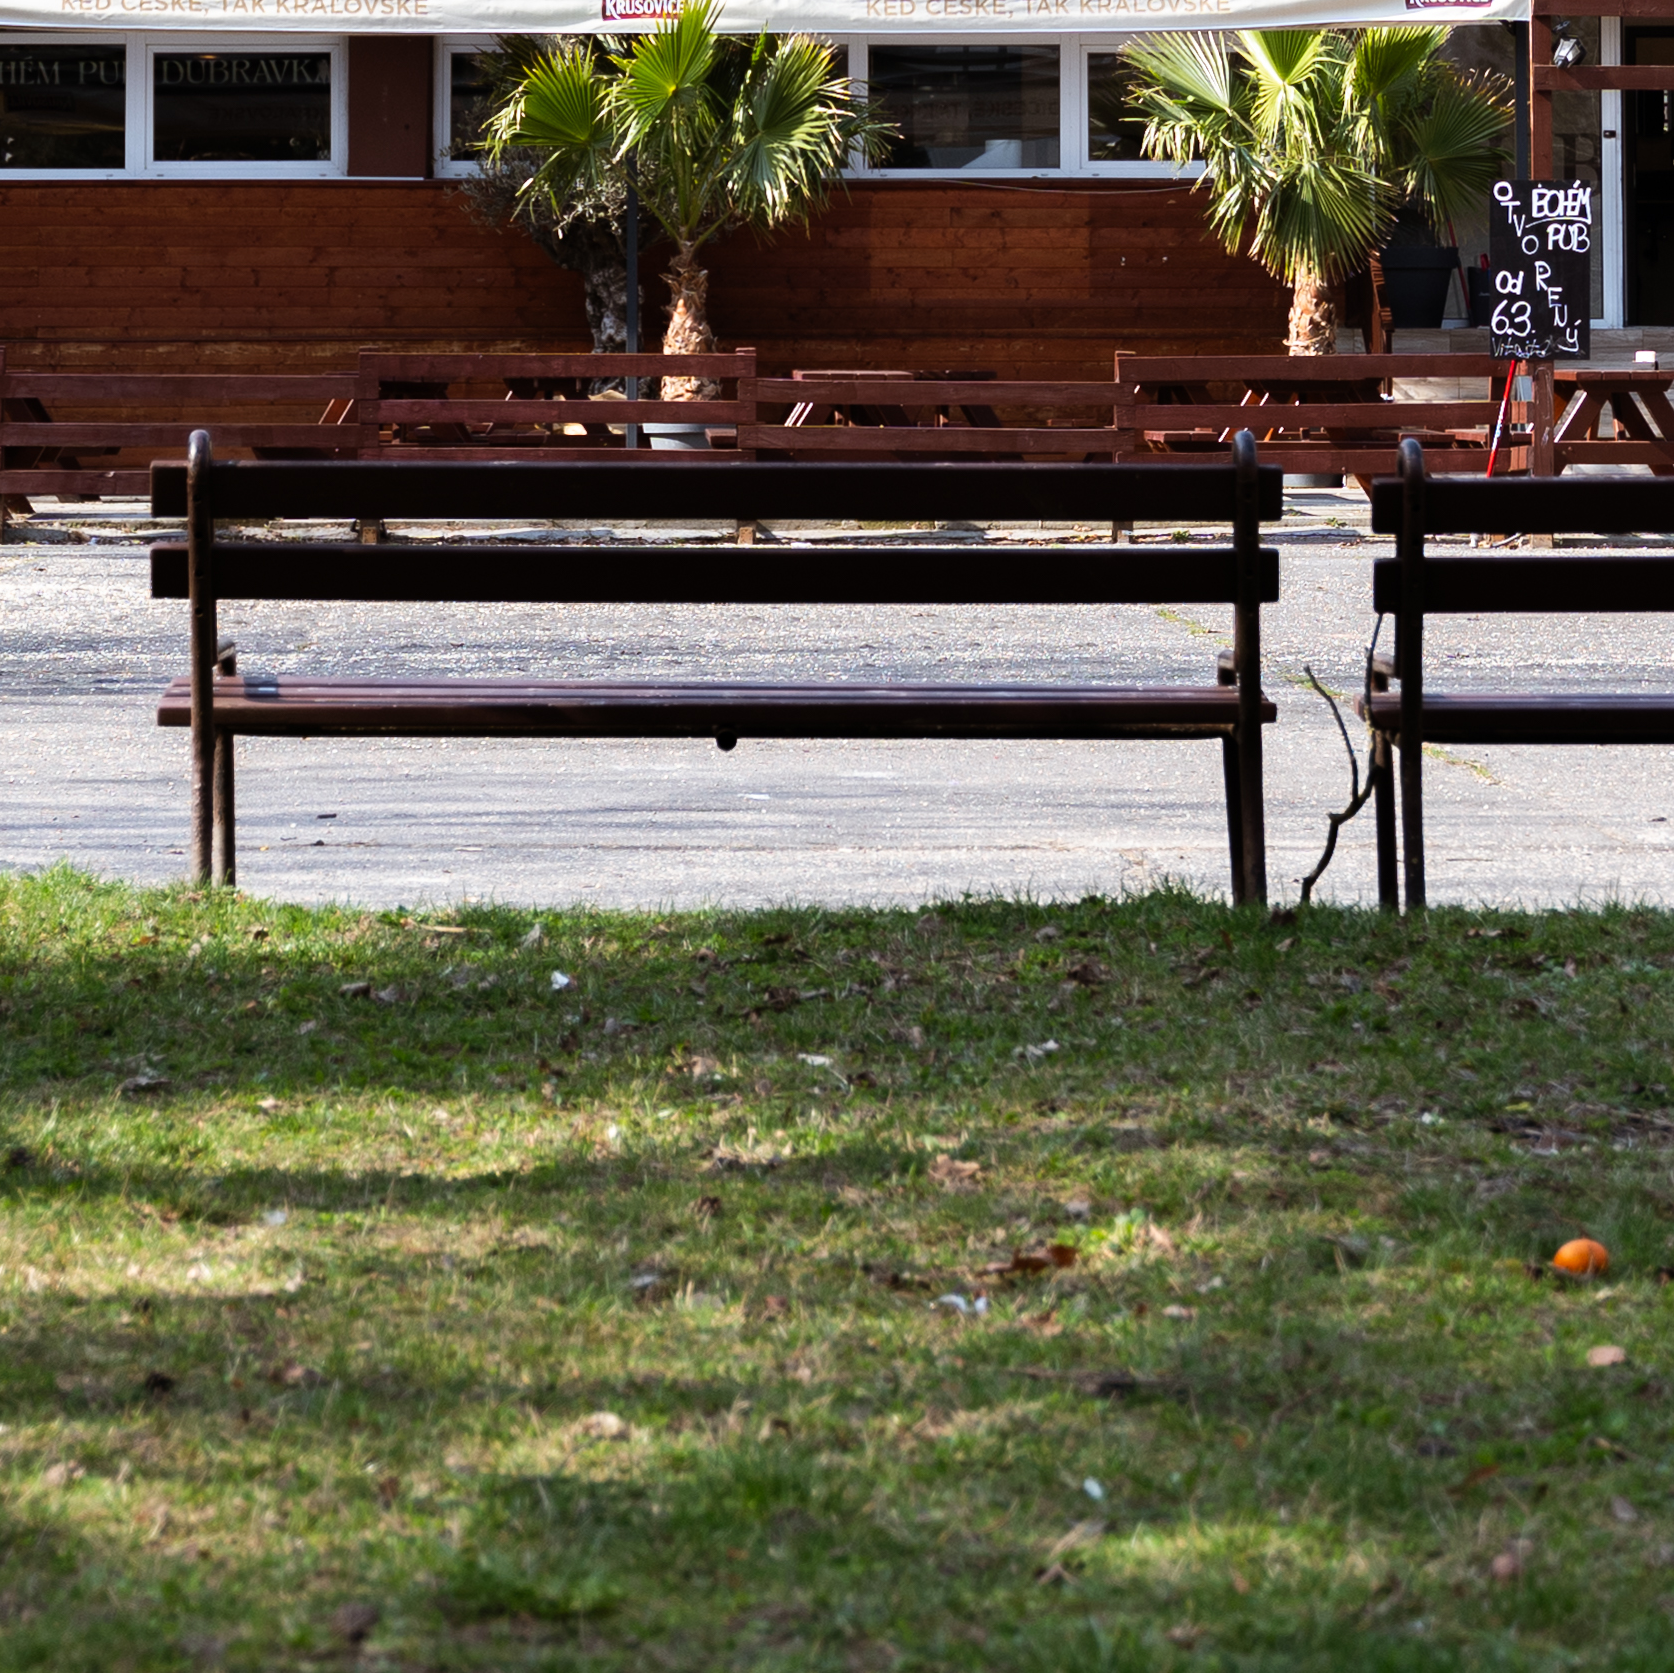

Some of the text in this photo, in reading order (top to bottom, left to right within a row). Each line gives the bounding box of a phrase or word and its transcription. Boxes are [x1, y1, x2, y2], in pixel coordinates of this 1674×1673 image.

[77, 60, 125, 85] PU
[1546, 223, 1590, 252] PUB
[1495, 270, 1524, 295] Od
